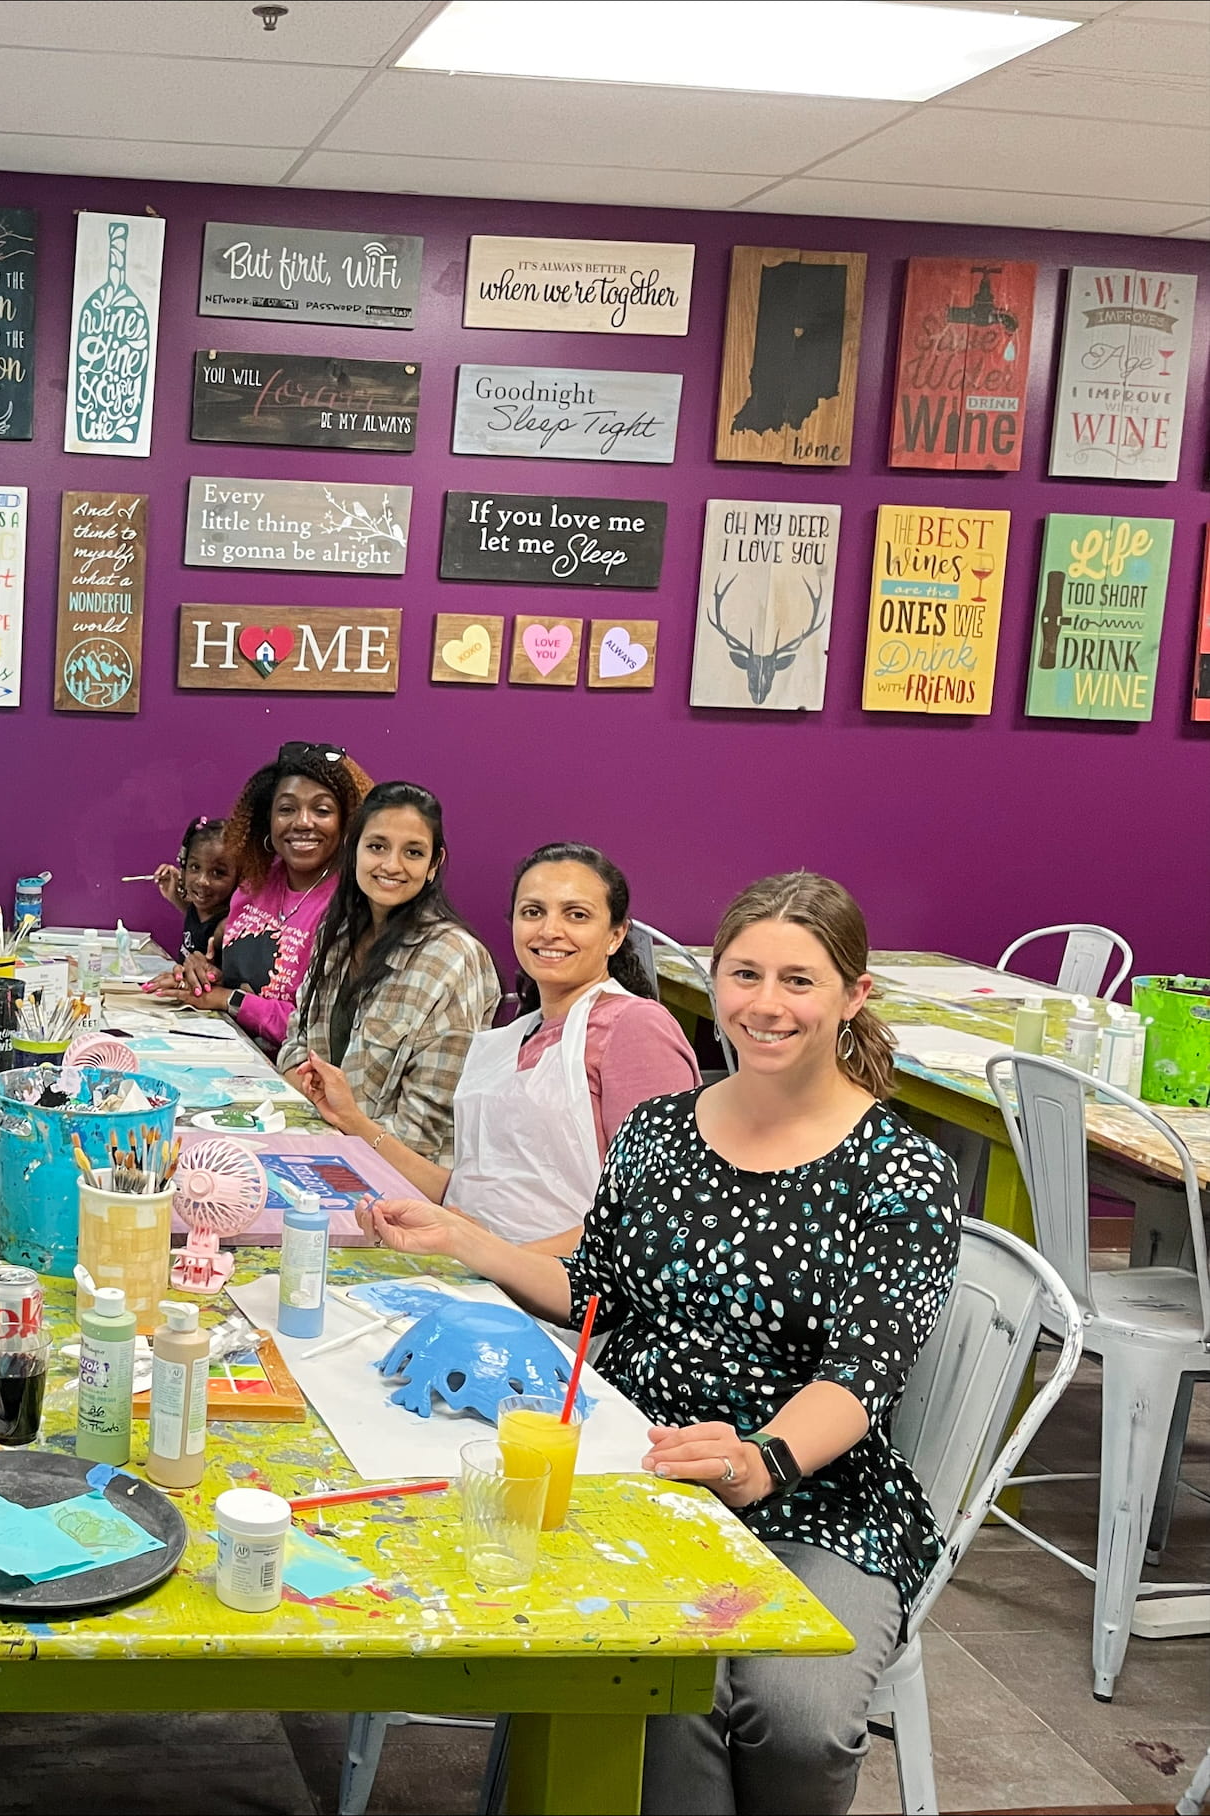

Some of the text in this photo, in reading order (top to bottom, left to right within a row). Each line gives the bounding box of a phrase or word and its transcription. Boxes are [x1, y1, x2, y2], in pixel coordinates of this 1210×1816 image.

[223, 242, 402, 291] But first, WiFi
[539, 262, 583, 273] ALWAYS
[585, 263, 627, 275] BETTER
[6, 271, 25, 291] THE
[479, 269, 542, 303] when
[1094, 275, 1172, 310] WINE
[1097, 310, 1165, 328] IMPROVES
[5, 331, 25, 350] THE
[914, 314, 998, 353] Save
[78, 334, 147, 377] Dine
[1081, 343, 1156, 379] Age
[203, 367, 262, 387] YOU WILL
[905, 353, 1015, 392] Water
[78, 371, 142, 420] & Enjoy
[475, 376, 596, 409] Goodnight
[968, 397, 1017, 410] DRINK
[1072, 387, 1173, 405] I IMPROVE
[77, 403, 118, 441] Life
[1105, 402, 1140, 416] WITH
[320, 413, 412, 435] BE MY ALWAYS
[487, 406, 665, 454] Sleep Tight
[902, 395, 1017, 454] Wine
[1070, 412, 1171, 450] WINE
[793, 435, 843, 463] home
[72, 500, 115, 519] And
[203, 484, 265, 509] Every
[12, 511, 20, 529] A
[201, 509, 312, 539] little thing
[469, 500, 646, 533] If you love me
[724, 511, 831, 539] OH MY DEER
[72, 523, 137, 541] think to
[893, 513, 995, 550] THE BEST
[200, 539, 392, 568] is gonna be alright
[479, 526, 629, 578] let me Sleep
[721, 539, 827, 566] I LOVE YOU
[885, 541, 966, 582] Wines
[1072, 522, 1154, 580] Life
[72, 570, 133, 588] what a
[893, 585, 954, 599] are the
[69, 592, 133, 615] WONDERFUL
[1068, 582, 1148, 610] TOO SHORT
[72, 617, 126, 634] world
[879, 601, 985, 639] ONES WE
[1072, 614, 1092, 632] to
[534, 637, 561, 649] LOVE
[535, 649, 558, 660] YOU
[604, 638, 638, 671] ALWAYS
[1061, 637, 1141, 673] DRINK
[874, 637, 978, 678] Drink
[877, 681, 905, 695] WITH
[1073, 673, 1149, 708] WINE
